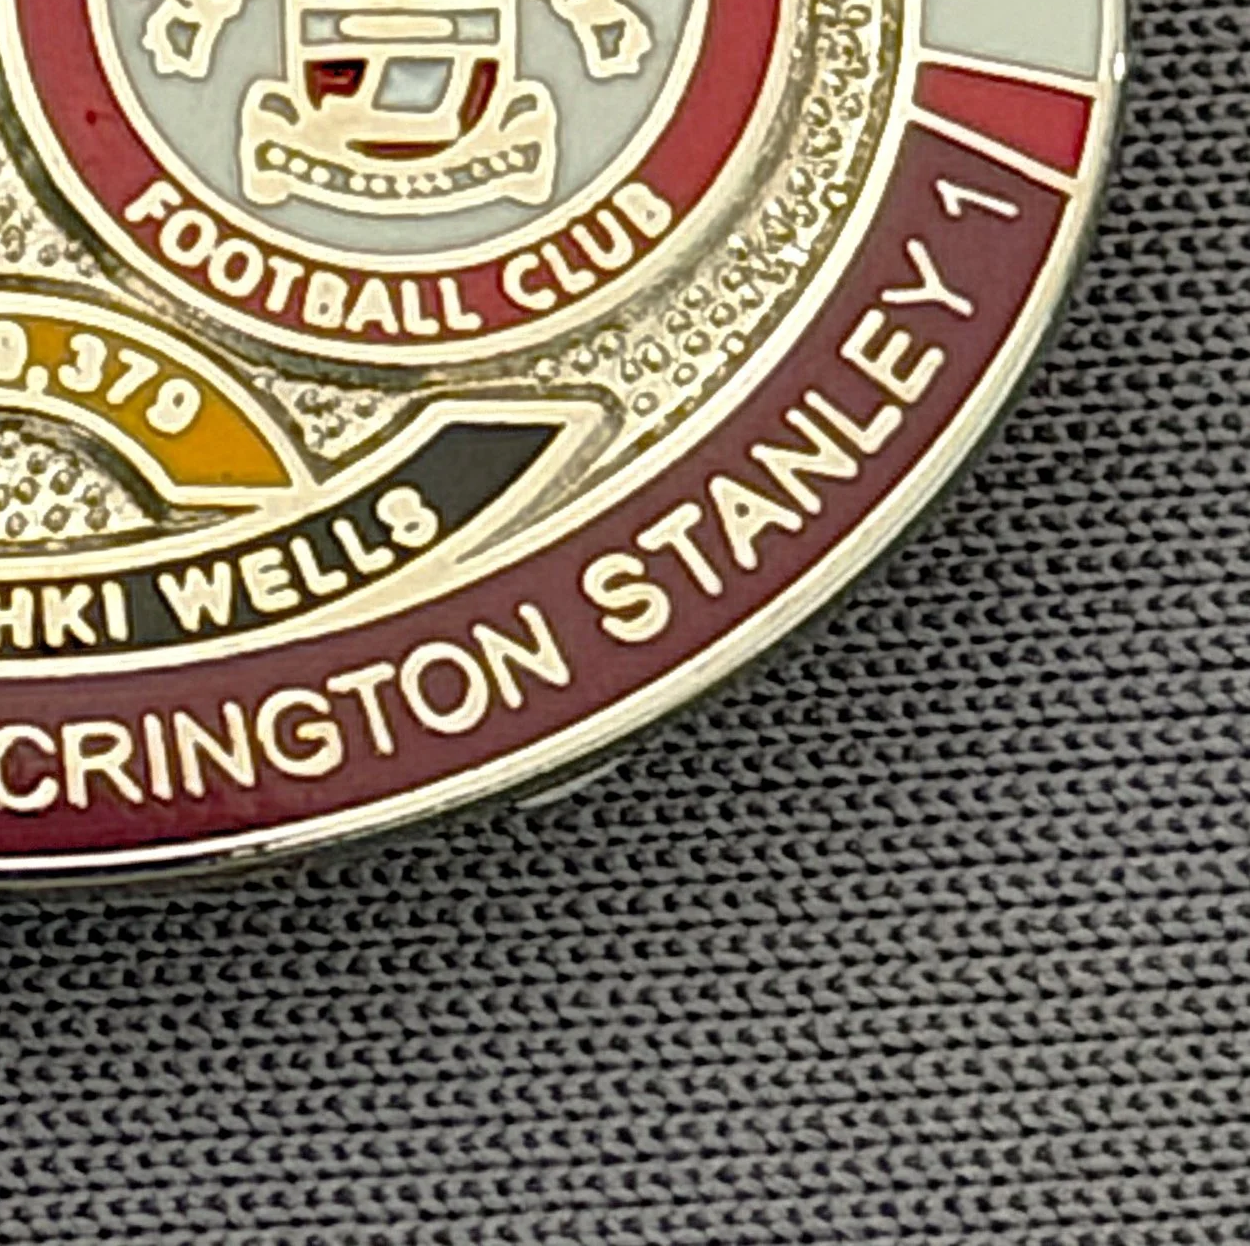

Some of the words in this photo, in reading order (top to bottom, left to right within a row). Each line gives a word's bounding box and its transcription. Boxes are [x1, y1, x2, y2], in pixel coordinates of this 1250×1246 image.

[126, 180, 481, 335] FOOTBALL
[502, 182, 674, 311] CLUB
[582, 238, 974, 643] STANLEY
[936, 179, 1019, 218] 1
[158, 486, 439, 633] WELLS
